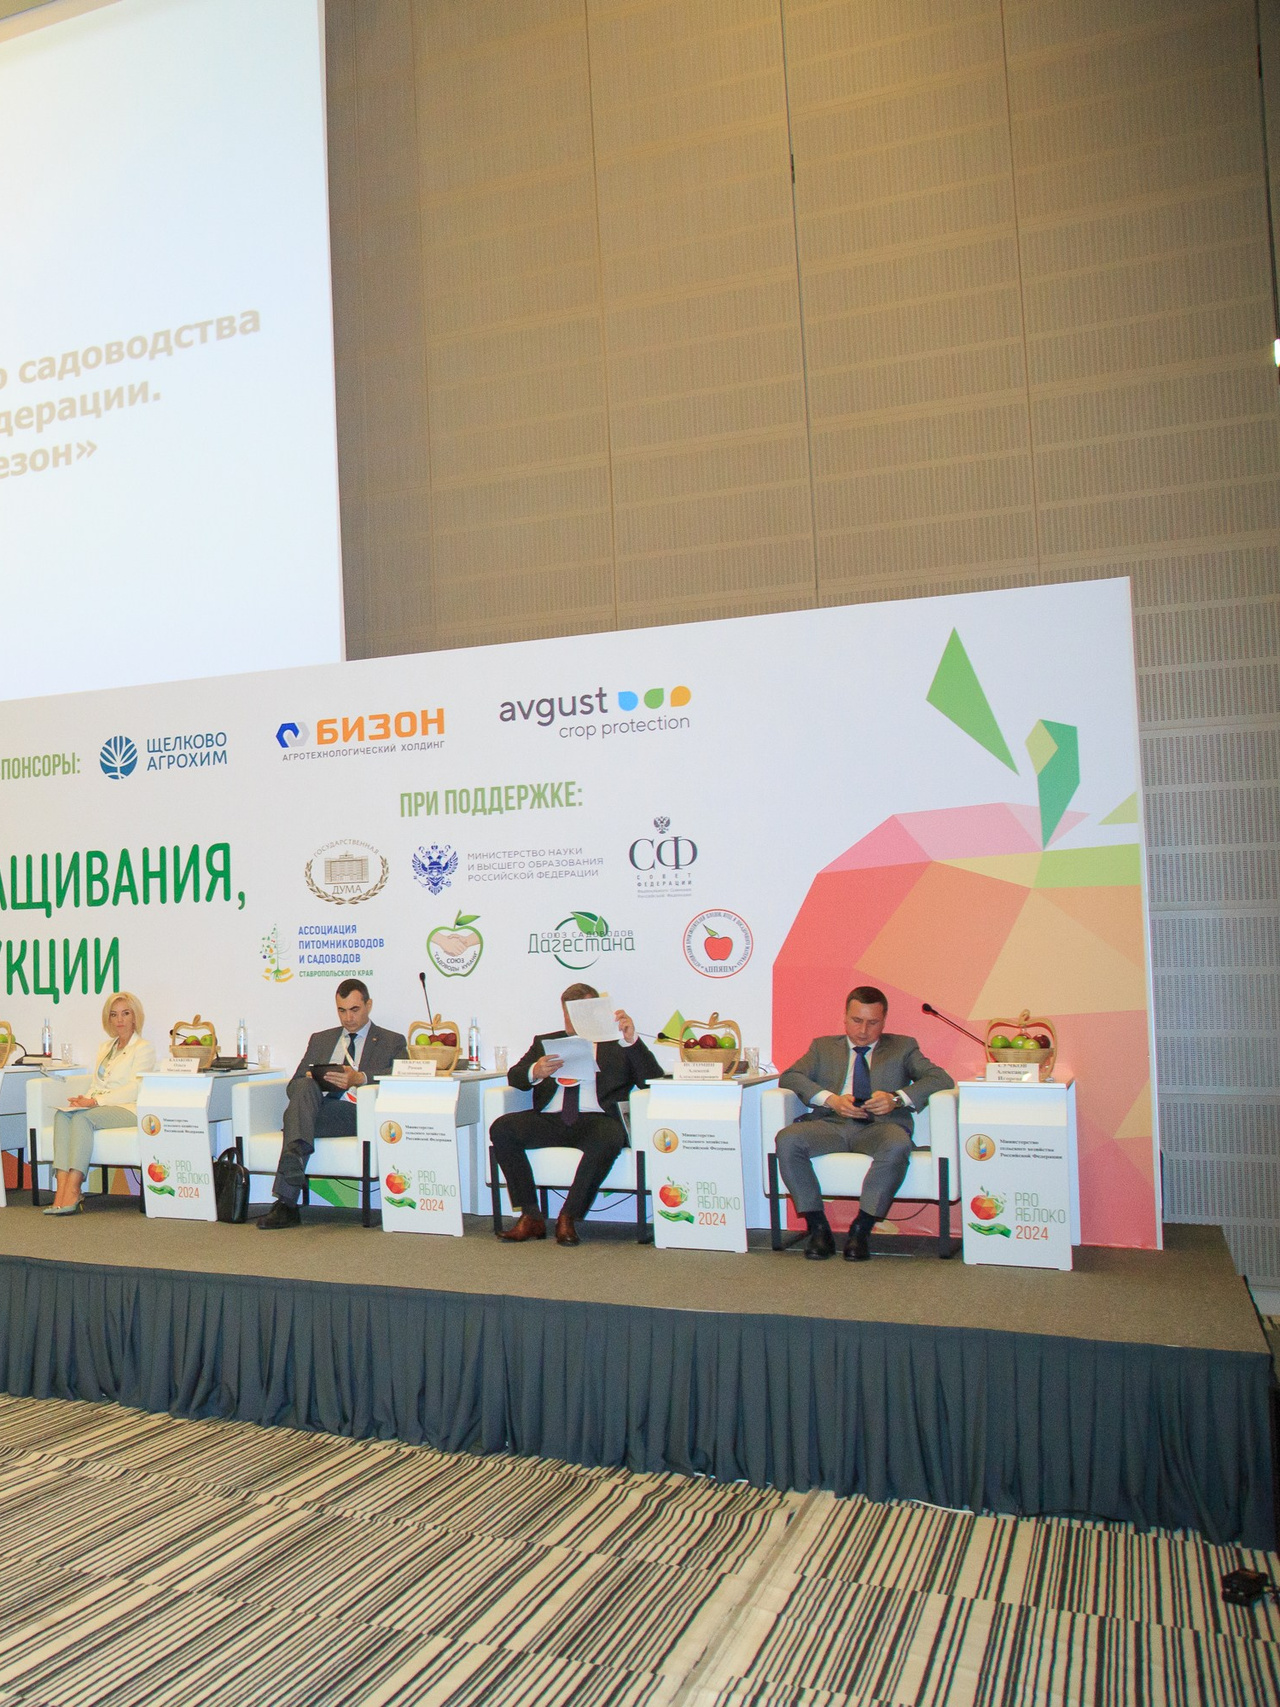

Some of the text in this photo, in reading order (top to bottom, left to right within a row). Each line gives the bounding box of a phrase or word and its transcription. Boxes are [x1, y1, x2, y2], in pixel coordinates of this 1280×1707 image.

[18, 309, 261, 384] садоводства
[499, 686, 608, 726] avgust
[316, 708, 445, 745] БИЗОН
[558, 714, 690, 740] crop protection
[146, 731, 228, 754] ЩЕЛКОВО
[282, 740, 446, 762] АГРОТЕХНОЛОГИЧЕСКИЙ ХОЛДИНГ
[146, 749, 228, 772] АГРОХИМ
[400, 780, 583, 818] ПРИ ПОДДЕРЖКЕ:
[313, 838, 380, 858] ГОСУДАРСТВЕННАЯ
[467, 848, 583, 860] МИНИСТЕРСТВО НАУКИ
[629, 836, 698, 871] СФ
[467, 857, 604, 871] И ВЫСШЕГО ОБРАЗОВАНИЯ
[468, 869, 599, 882] РОССИЙСКОЙ ФЕДЕРАЦИИ
[332, 885, 362, 895] ДУМА
[298, 924, 357, 936] АССОЦИАЦИЯ
[541, 930, 634, 939] СОЮЗ САДОВОДОВ
[298, 938, 385, 949] ПИТОМНИКОВОДОВ
[528, 933, 635, 954] Дагестана
[299, 953, 361, 964] И САДОВОДОВ
[299, 970, 356, 978] СТАВРОПОЛЬСКОГО
[175, 1160, 192, 1172] PRO
[176, 1172, 210, 1185] ЯБЛОКО
[417, 1170, 436, 1183] PRO
[178, 1186, 200, 1198] 2024
[419, 1183, 456, 1197] ЯБЛОКО
[696, 1181, 717, 1196] PRO
[420, 1198, 444, 1211] 2024
[697, 1196, 741, 1210] ЯБЛОКО
[1015, 1192, 1039, 1207] PRO
[698, 1212, 727, 1226] 2024
[1015, 1208, 1066, 1224] ЯБЛОКО
[1016, 1225, 1049, 1240] 2024
